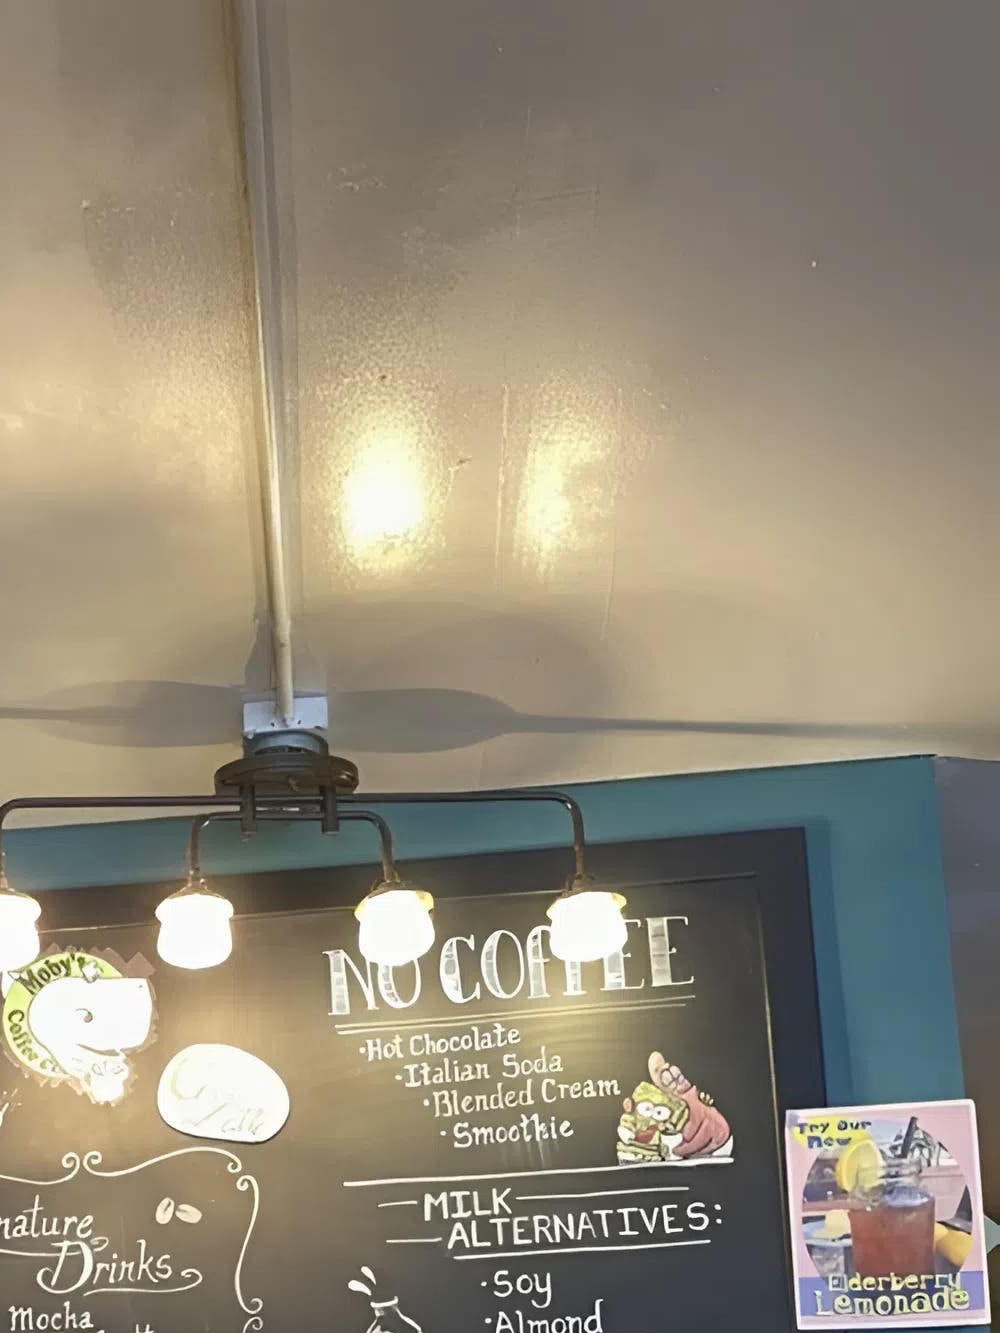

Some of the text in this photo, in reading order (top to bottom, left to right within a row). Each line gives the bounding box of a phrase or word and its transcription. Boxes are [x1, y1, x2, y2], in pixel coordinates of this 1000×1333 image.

[365, 1023, 521, 1061] Hot Chocolate
[404, 1046, 563, 1088] Italian Soda
[434, 1074, 621, 1117] Blended Cream
[453, 1113, 574, 1148] Smoothie
[423, 1187, 512, 1221] MILK
[447, 1201, 723, 1249] ALTERNATIVES:
[37, 1239, 173, 1294] Drinks
[828, 1271, 961, 1292] Elderberry
[493, 1270, 552, 1308] Soy
[814, 1287, 970, 1317] Lemonade
[9, 1301, 94, 1332] Mocha
